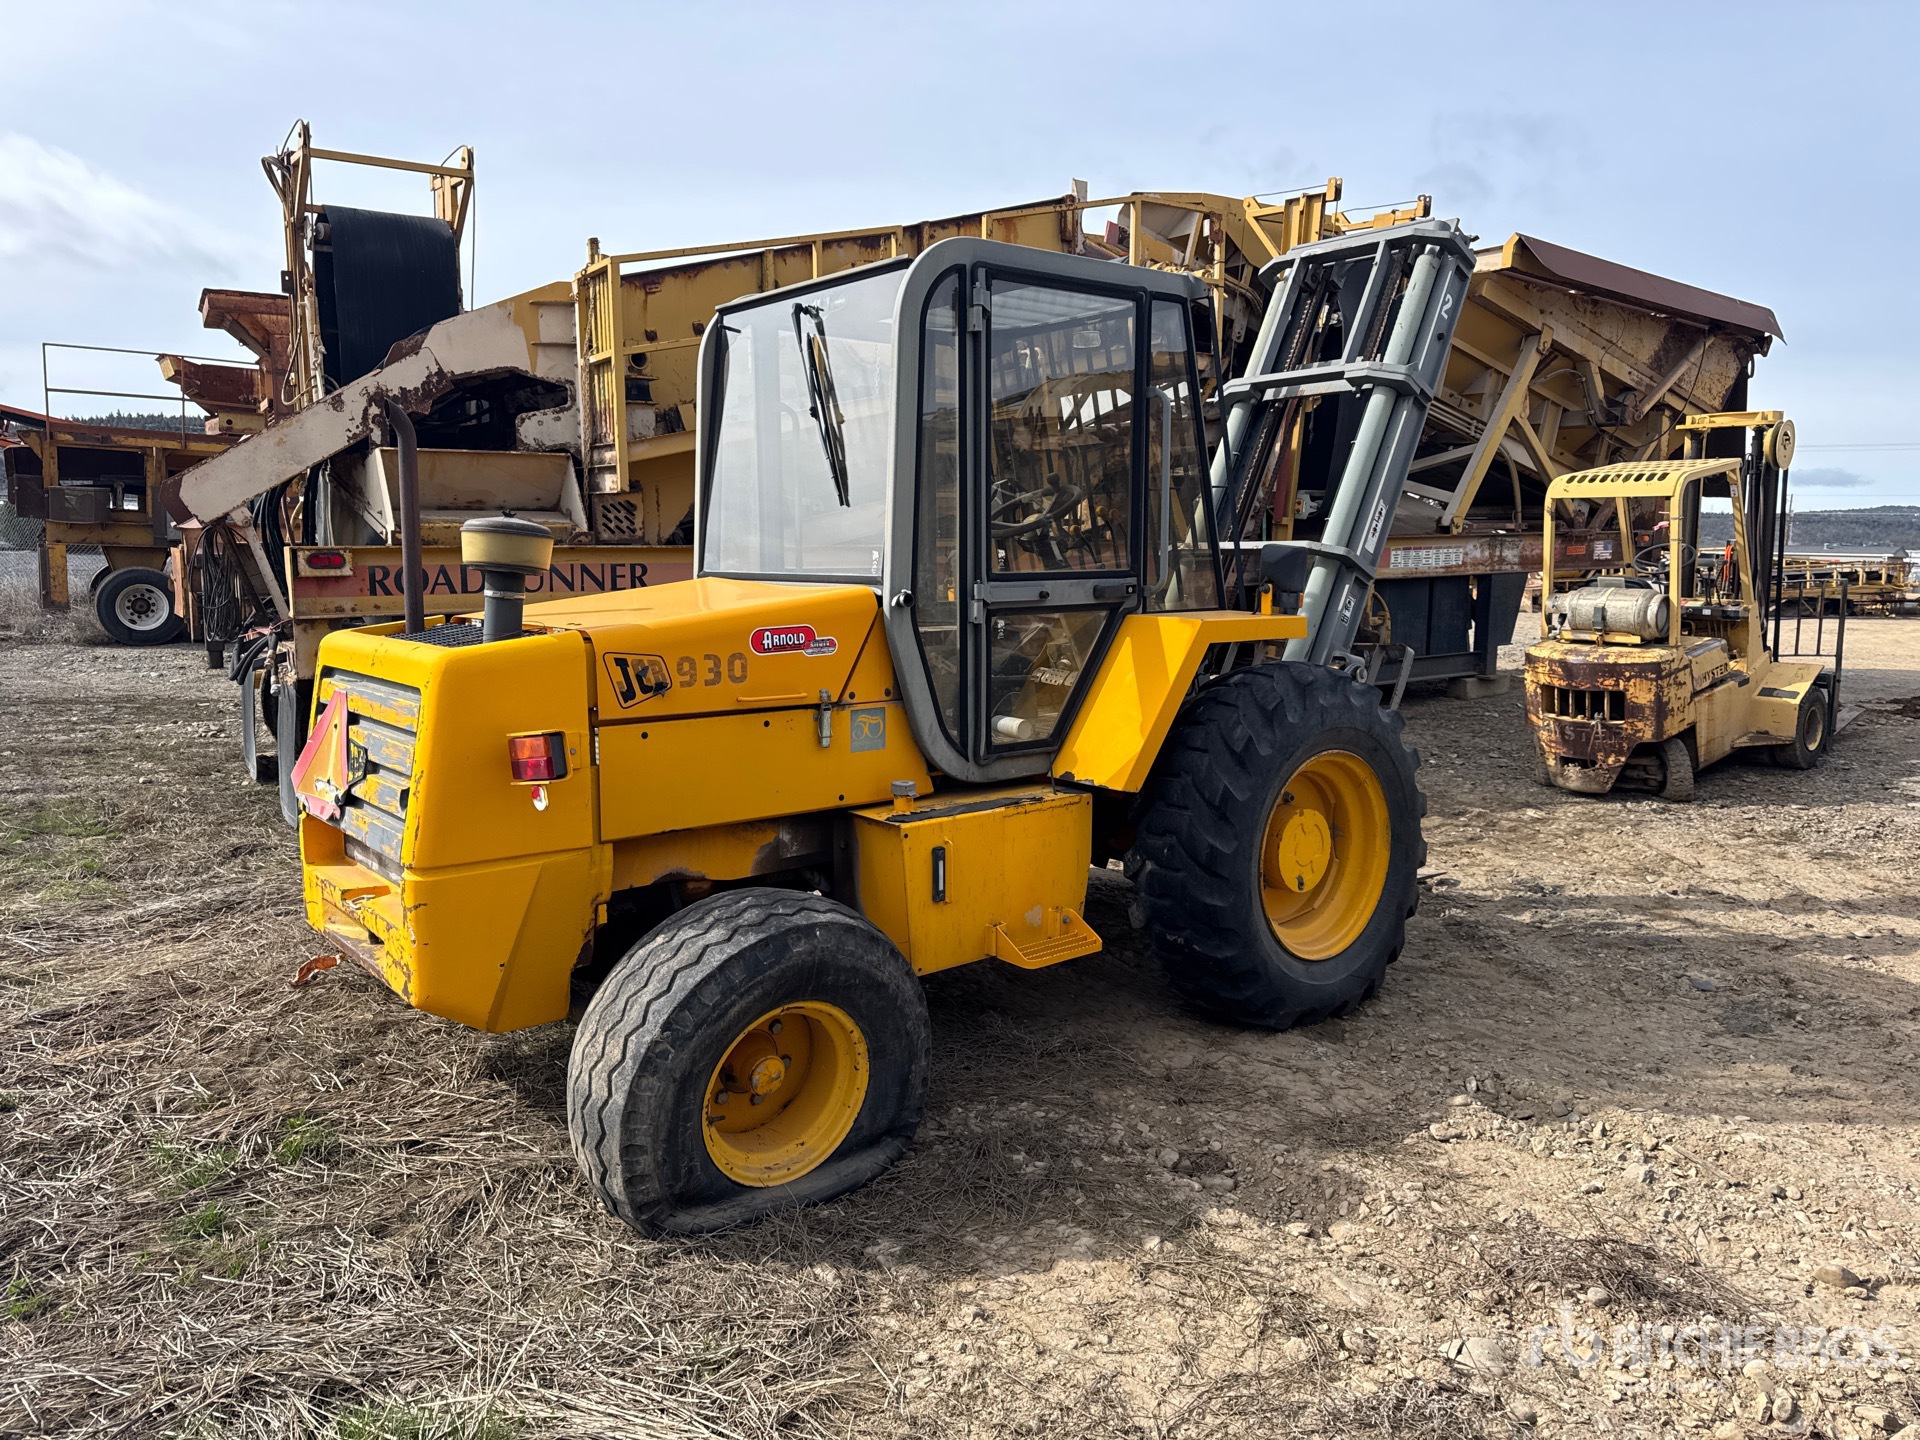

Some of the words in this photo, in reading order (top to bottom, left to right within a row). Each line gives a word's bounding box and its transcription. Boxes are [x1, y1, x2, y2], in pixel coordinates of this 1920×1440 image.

[1441, 293, 1453, 320] 2
[762, 630, 805, 650] ARNOLD
[676, 651, 748, 689] 930
[1701, 663, 1729, 683] HYSTER
